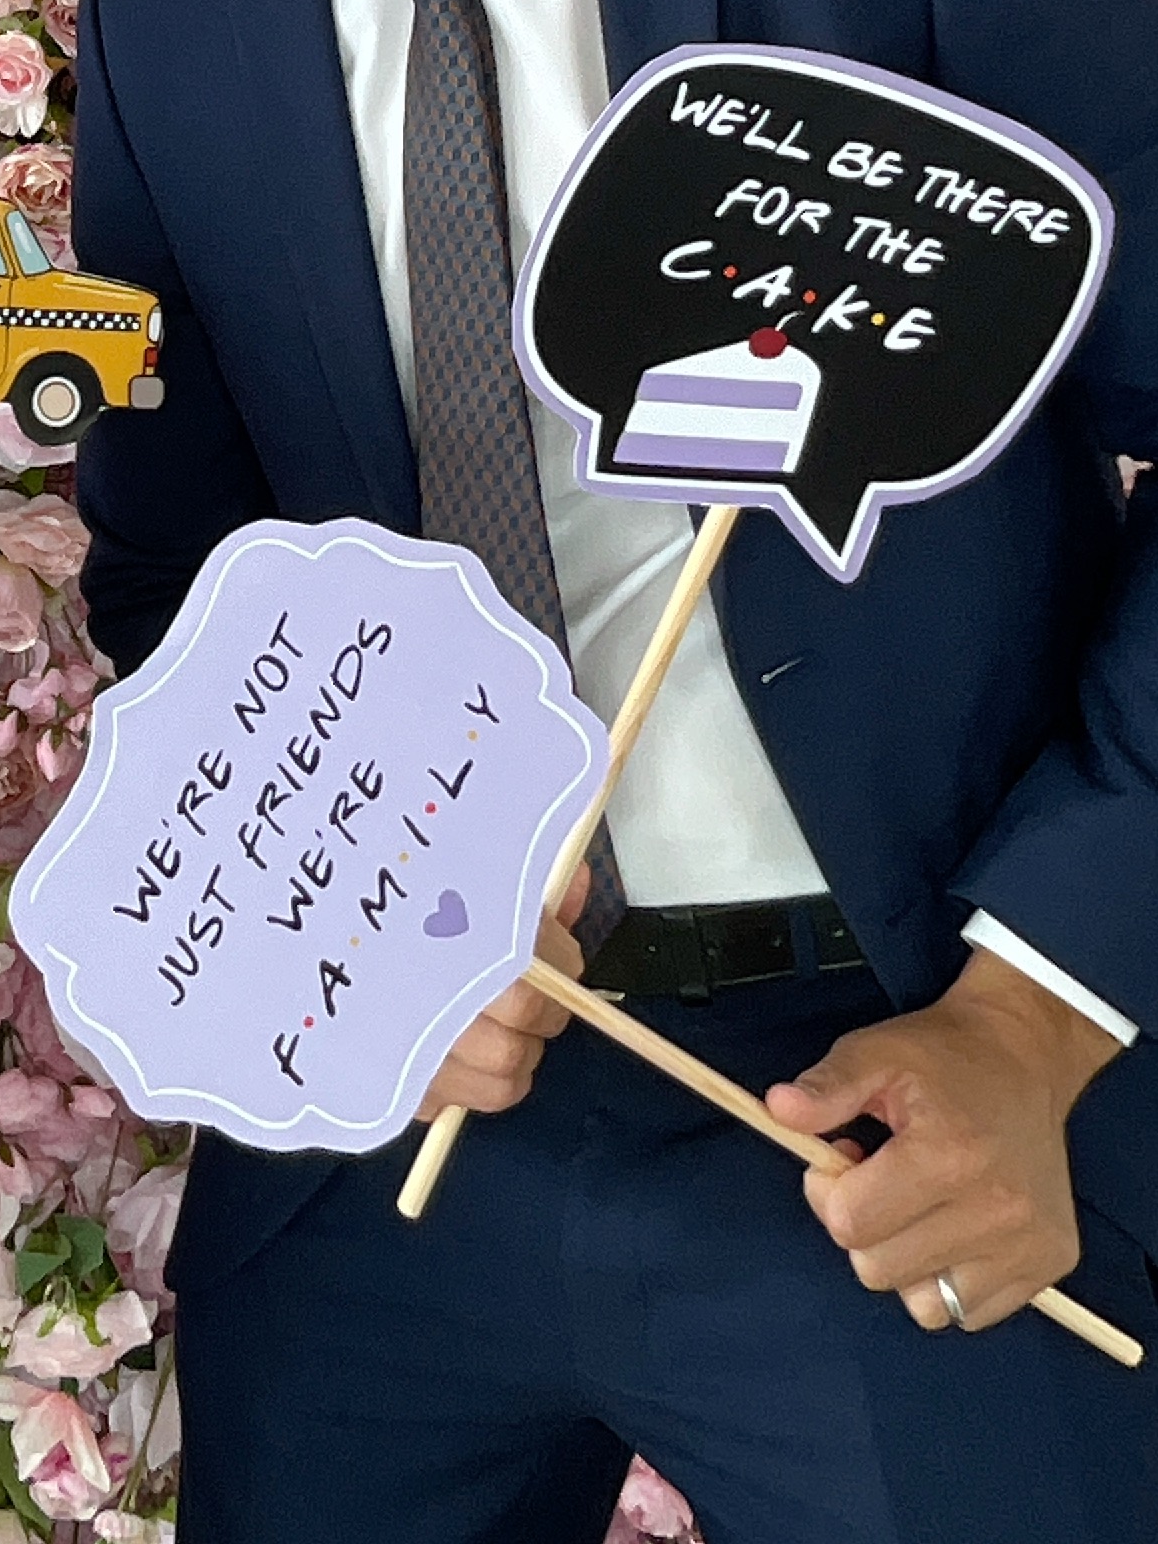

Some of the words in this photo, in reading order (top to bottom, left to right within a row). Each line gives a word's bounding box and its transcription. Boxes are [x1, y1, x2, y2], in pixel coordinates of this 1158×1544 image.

[669, 81, 812, 162] WE'LL
[827, 141, 905, 188] BE
[914, 165, 1073, 245] THERE
[715, 179, 832, 236] FOR
[844, 214, 946, 274] THE
[113, 748, 233, 925] WE'RE
[233, 611, 304, 734] NOT
[157, 864, 236, 1007] JUST
[238, 617, 394, 869] FRIENDS
[267, 758, 384, 933] WE'RE
